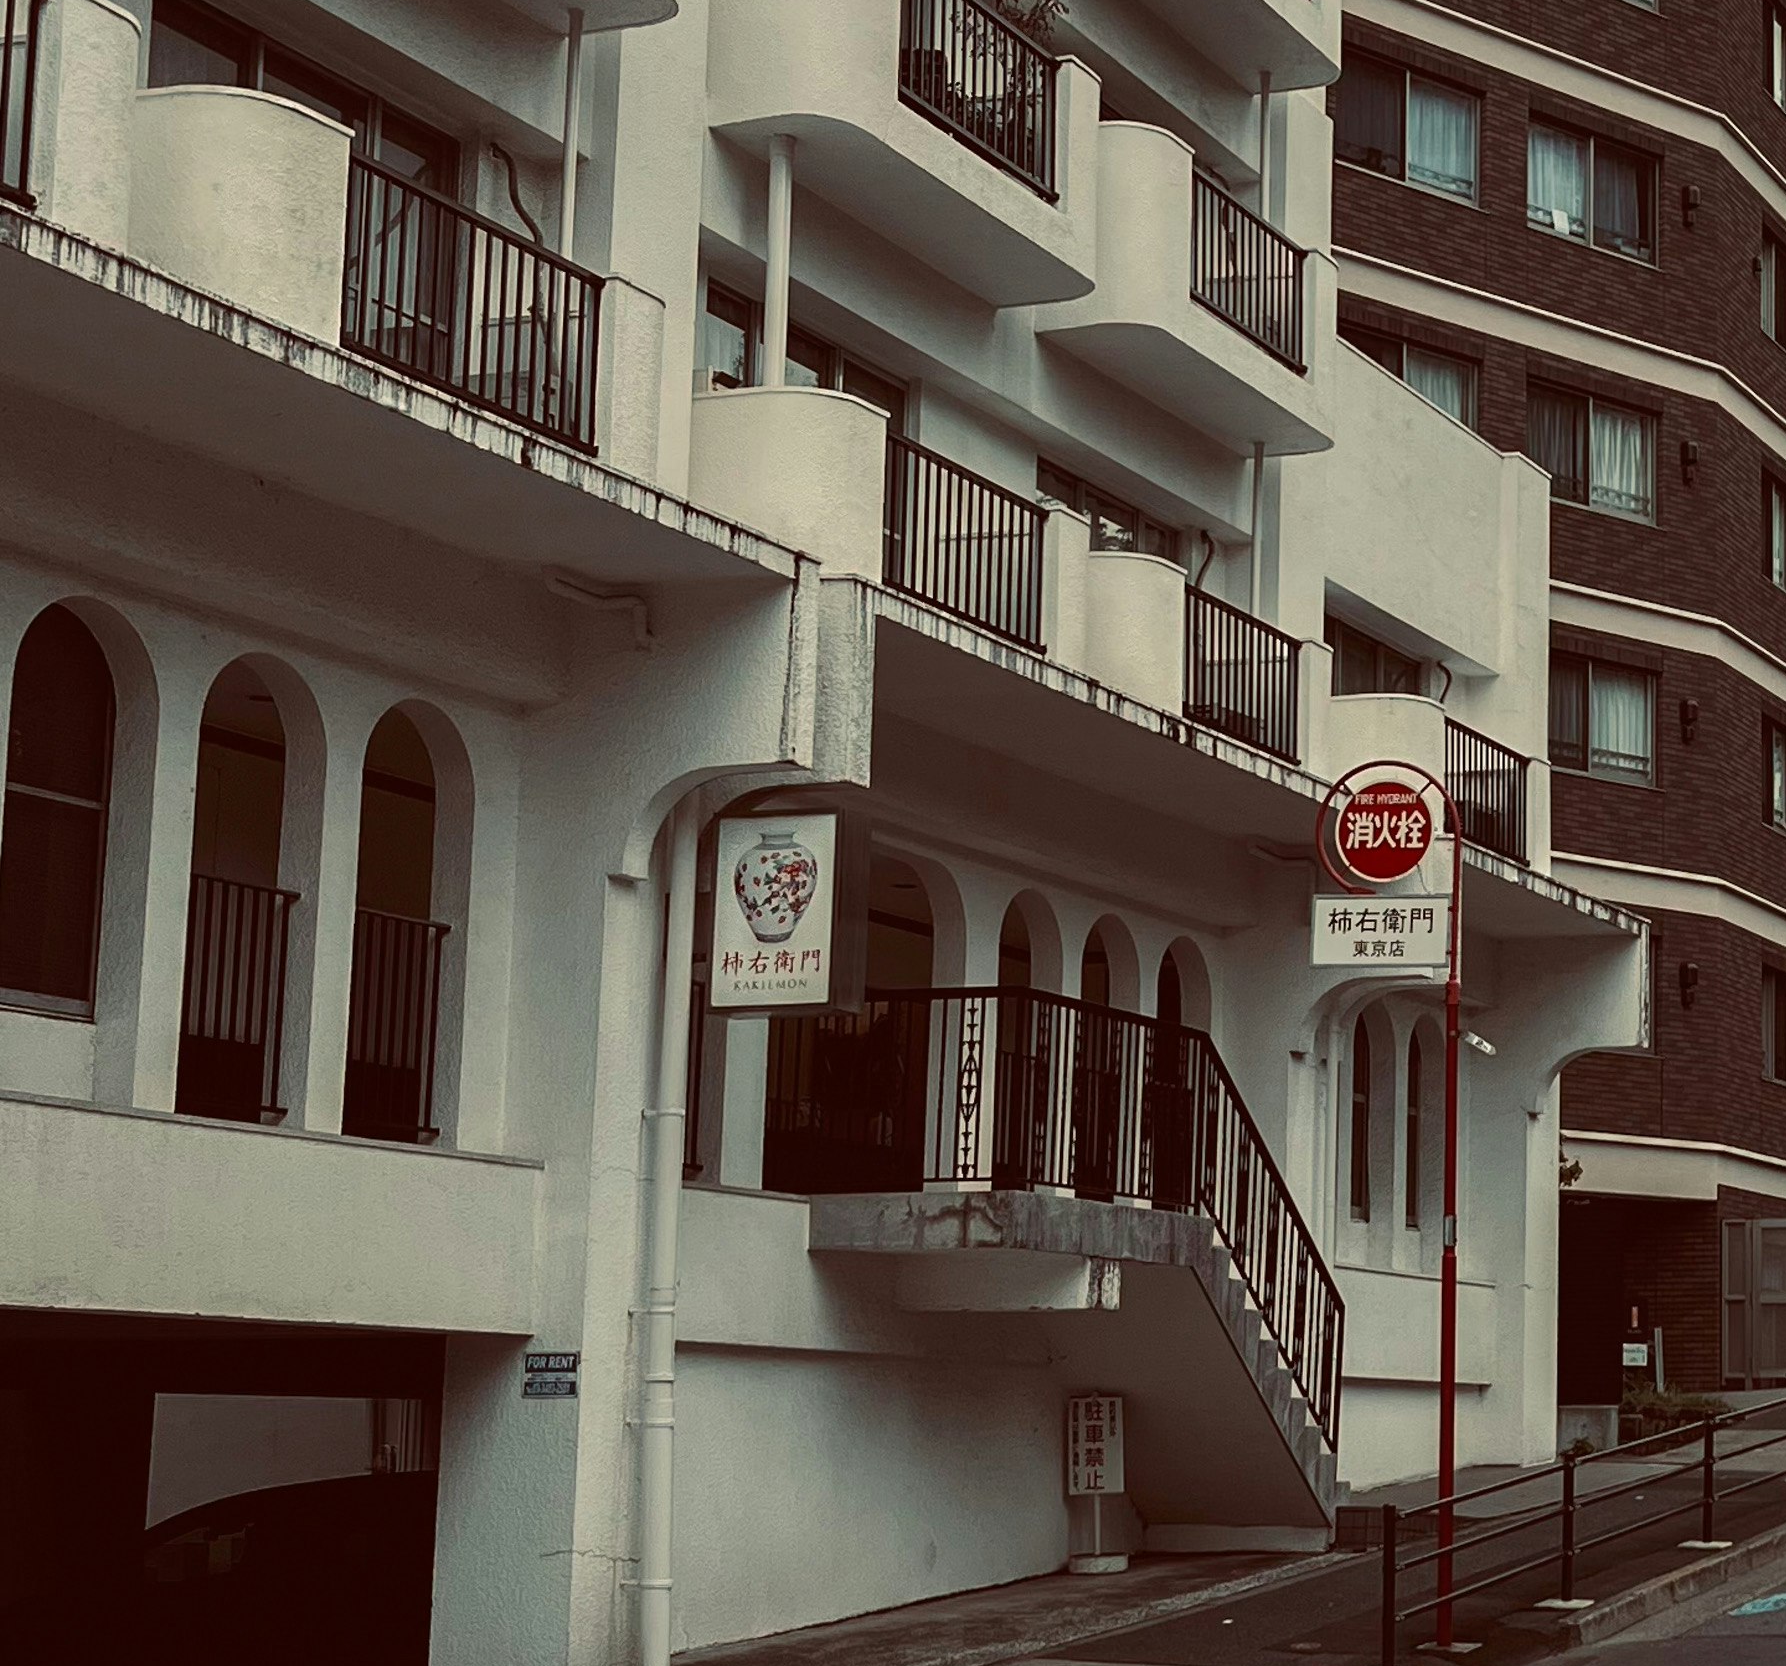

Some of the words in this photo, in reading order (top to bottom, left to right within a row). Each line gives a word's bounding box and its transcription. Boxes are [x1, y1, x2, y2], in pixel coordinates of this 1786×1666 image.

[1354, 794, 1374, 806] FIRE
[1377, 794, 1419, 806] HYDRANT
[1346, 810, 1427, 850] 消火栓
[1328, 907, 1434, 935] 柿右衛門
[1352, 939, 1406, 958] 東京店
[721, 948, 821, 976] 柿右衛門
[733, 979, 808, 991] KAKIEMON
[527, 1355, 547, 1369] FOR
[548, 1355, 575, 1369] RENT
[1084, 1400, 1105, 1490] 駐車禁止
